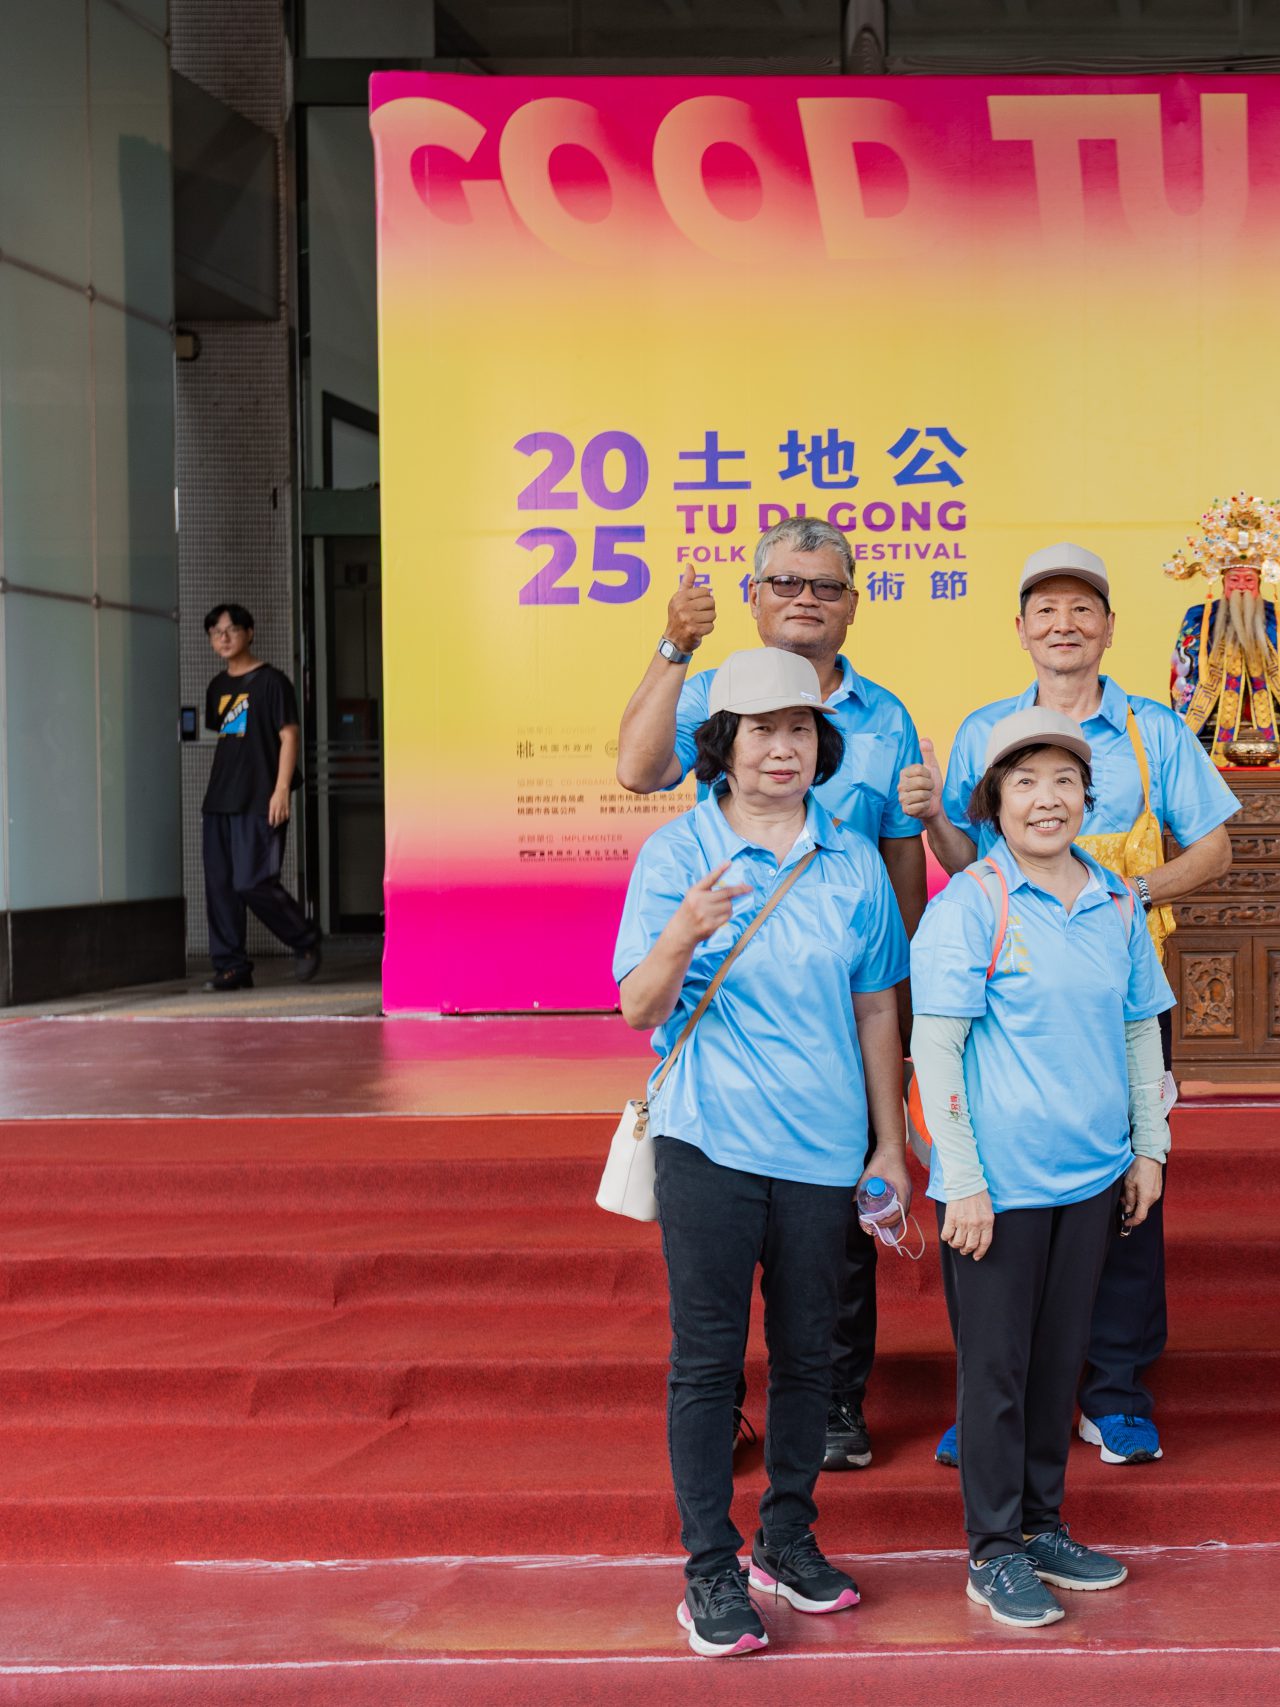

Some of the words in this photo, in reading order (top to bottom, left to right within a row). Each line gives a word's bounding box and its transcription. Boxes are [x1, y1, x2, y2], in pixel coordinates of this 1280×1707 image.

[371, 95, 920, 264] GOOD
[987, 93, 1248, 255] TU
[512, 430, 649, 511] 20
[673, 427, 968, 490] 土地公
[676, 504, 737, 534] TU
[827, 501, 967, 532] GONG
[677, 546, 746, 562] FOLK
[852, 543, 967, 560] ESTIVAL
[514, 525, 651, 606] 25
